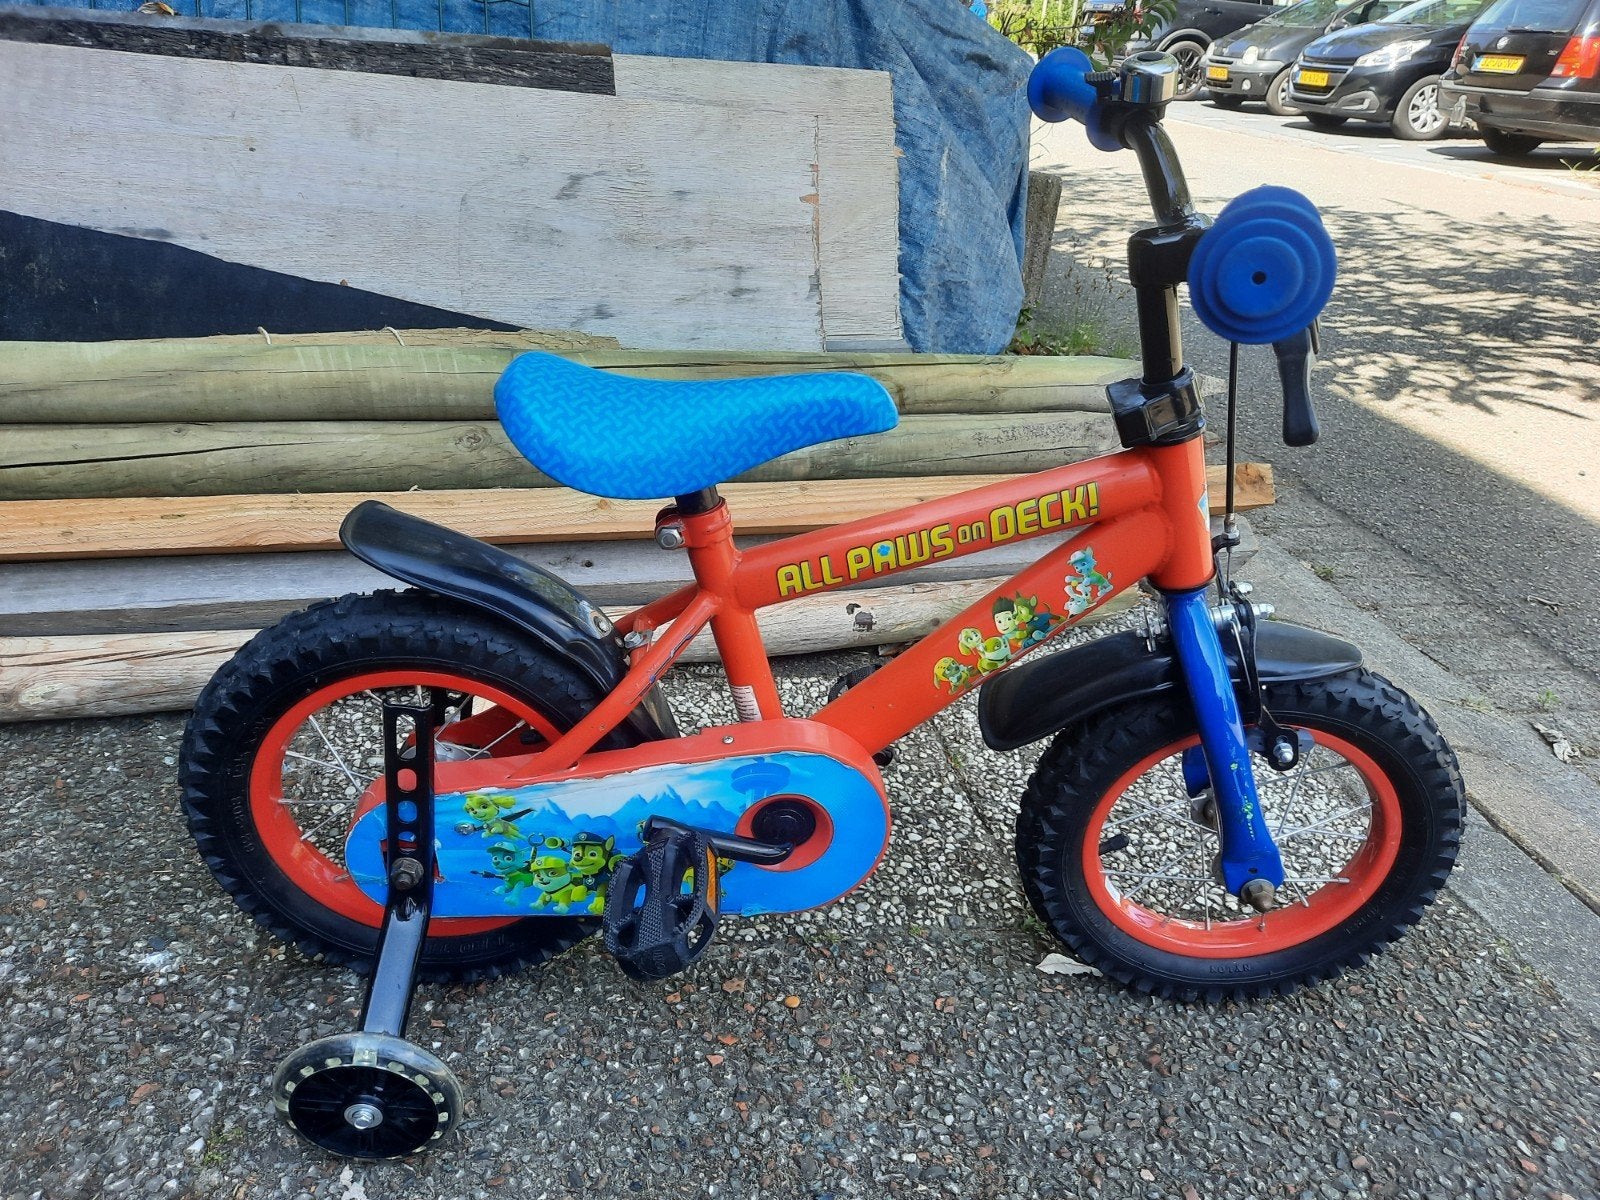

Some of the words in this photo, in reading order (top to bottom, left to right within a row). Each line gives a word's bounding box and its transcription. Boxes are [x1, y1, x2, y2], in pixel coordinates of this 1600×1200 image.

[777, 556, 843, 597] ALL
[845, 523, 955, 580] PAWS
[957, 521, 986, 545] on
[989, 482, 1098, 543] DECK!
